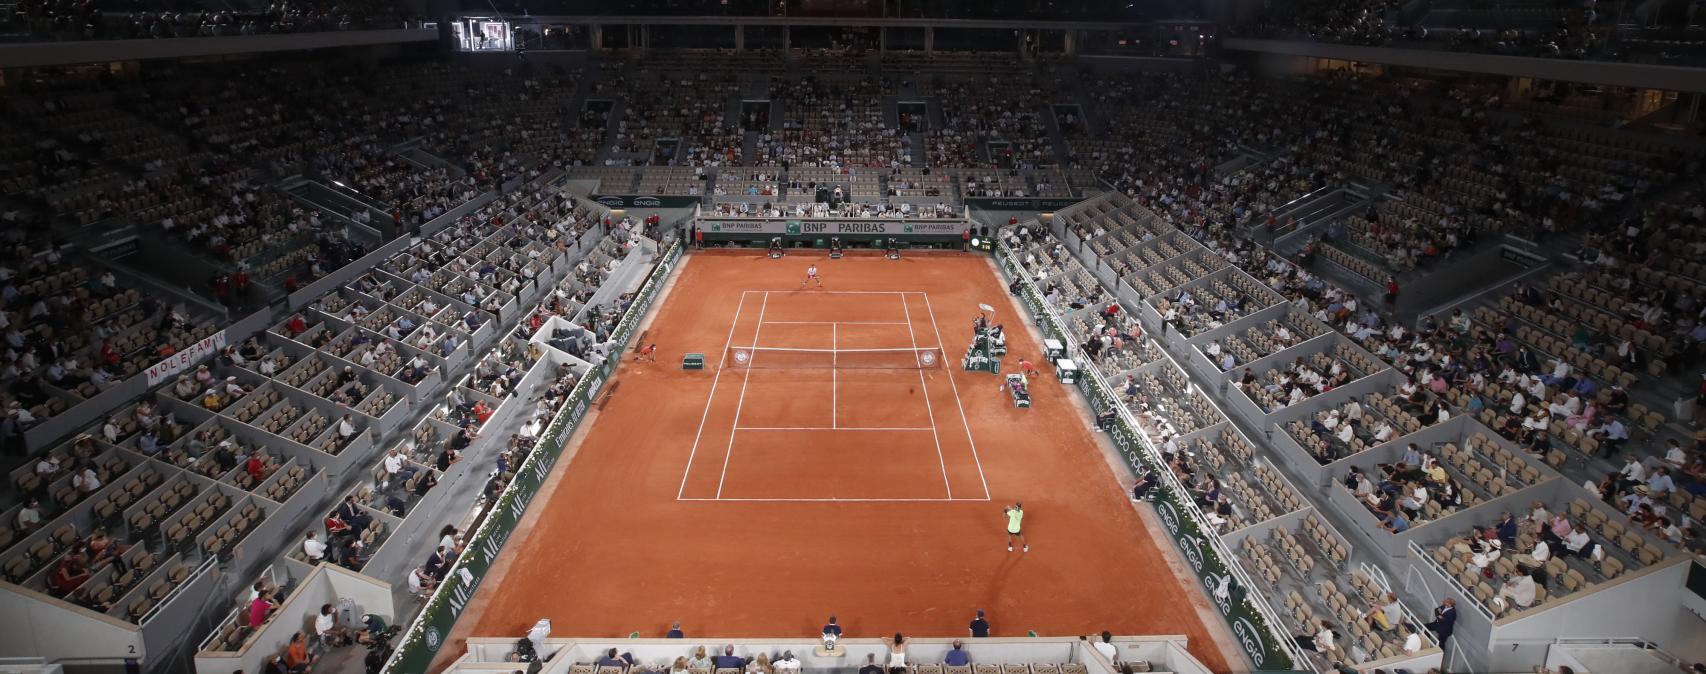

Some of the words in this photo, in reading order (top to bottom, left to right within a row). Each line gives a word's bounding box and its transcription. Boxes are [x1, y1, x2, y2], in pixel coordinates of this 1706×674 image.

[804, 223, 827, 232] BNP
[838, 223, 885, 232] PARIBAS
[1112, 424, 1129, 452] oppo
[128, 645, 136, 654] 2
[1512, 643, 1519, 652] 7
